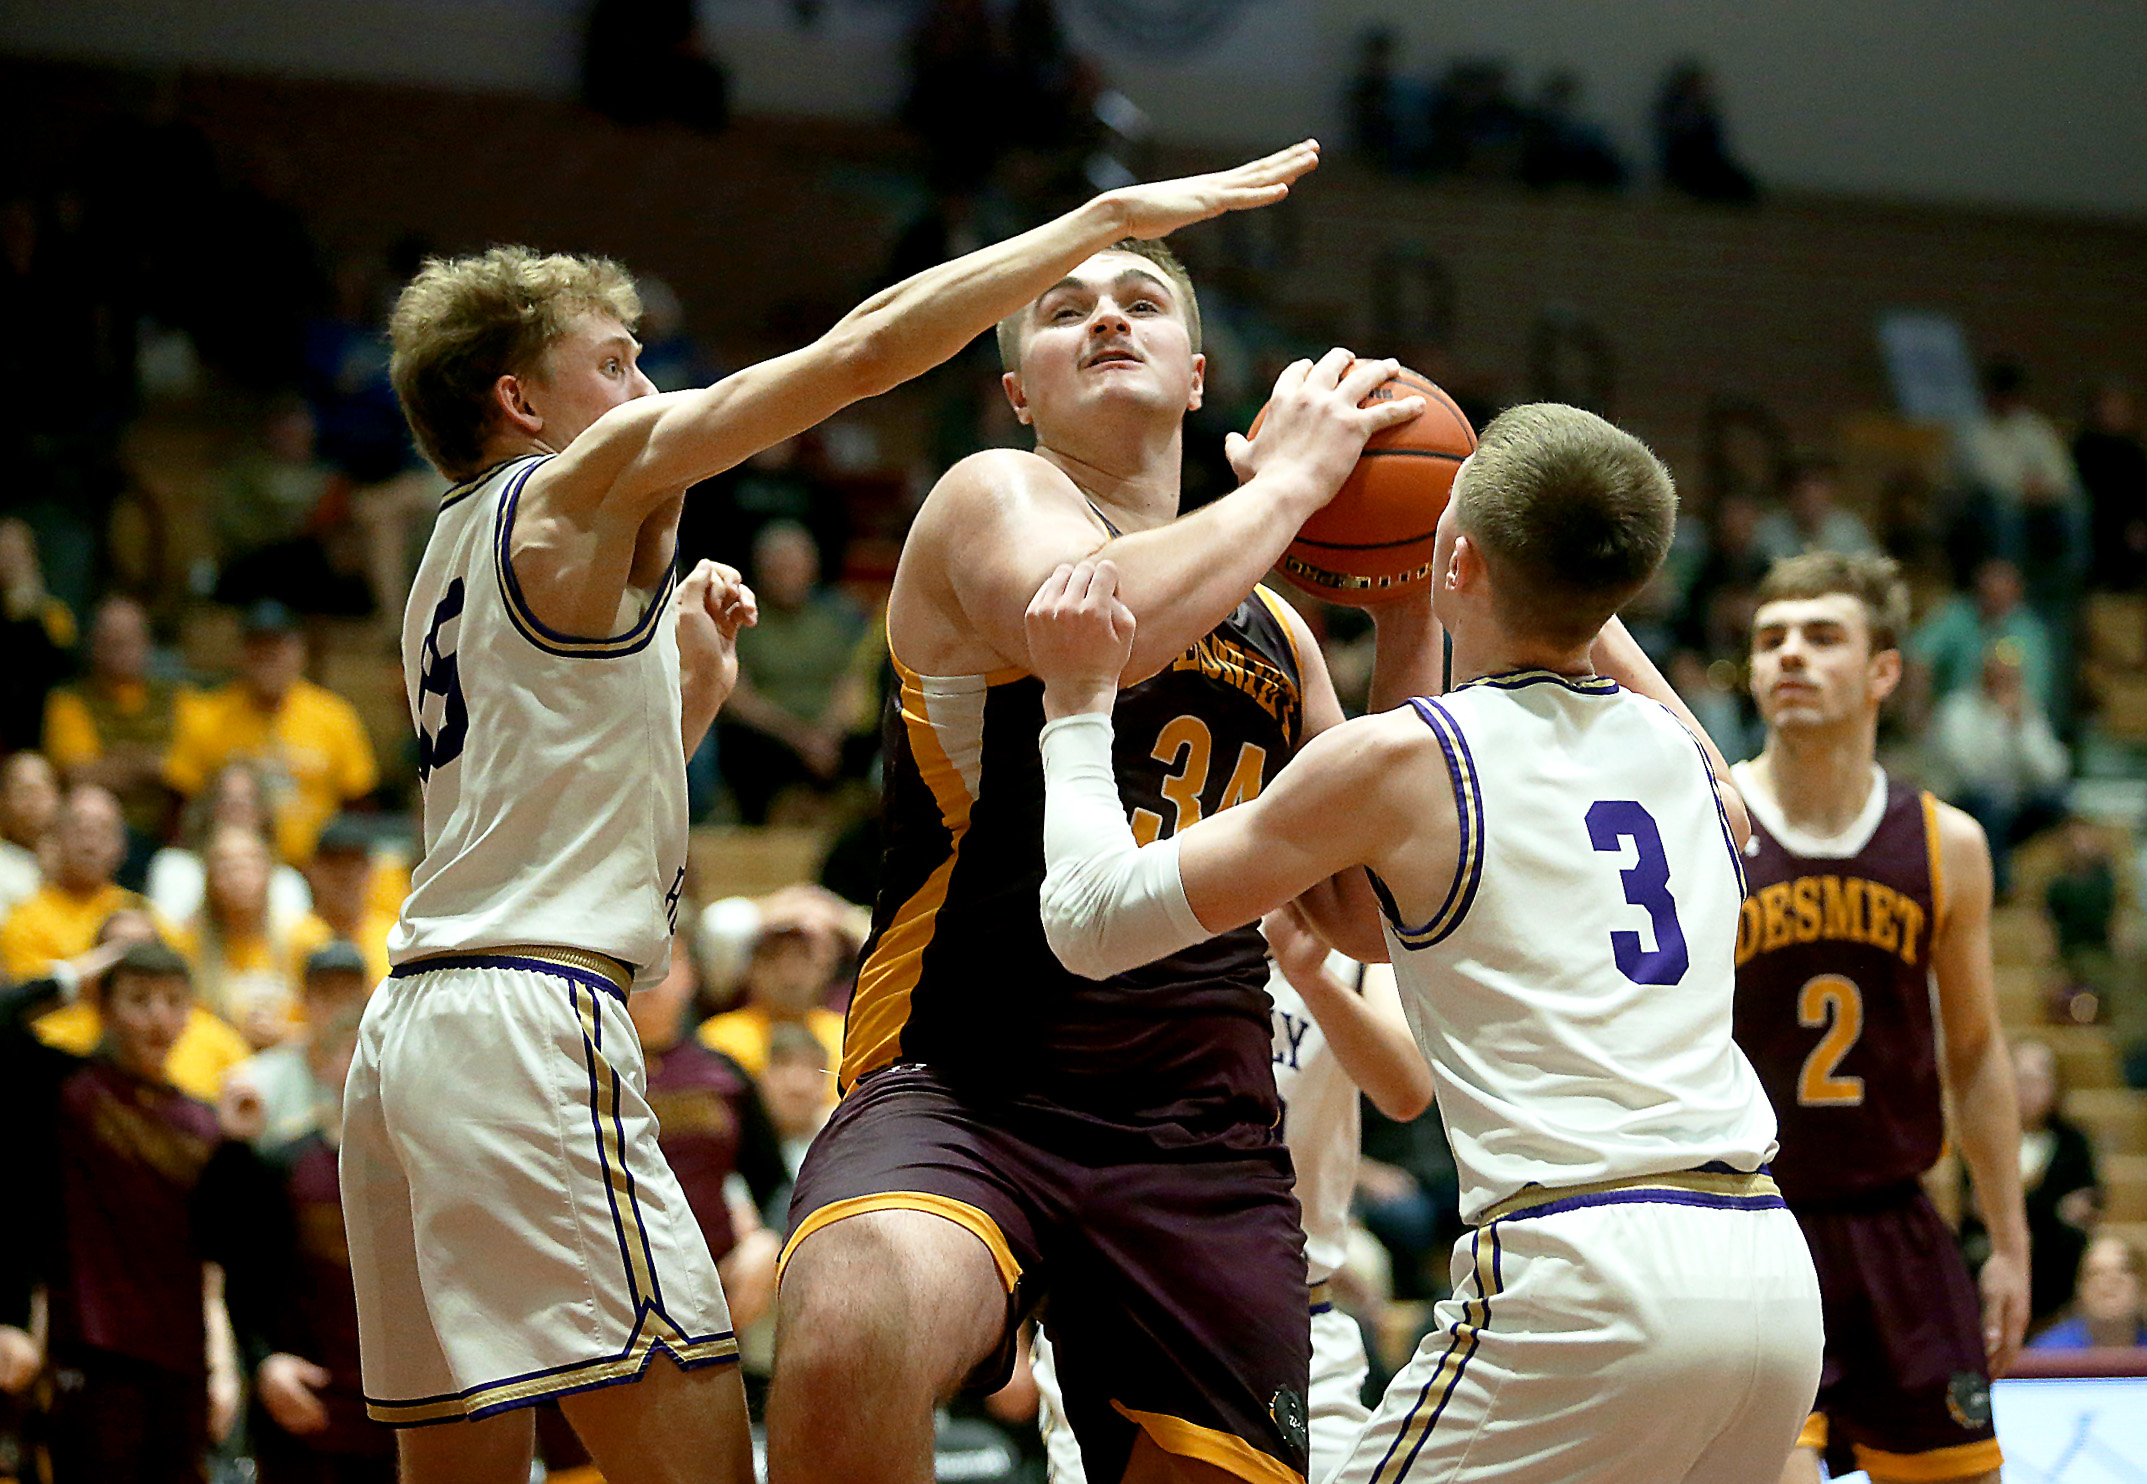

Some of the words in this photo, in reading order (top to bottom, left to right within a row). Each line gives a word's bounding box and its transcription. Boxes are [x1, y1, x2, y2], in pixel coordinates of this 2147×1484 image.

[1584, 801, 1689, 986] 3
[1735, 875, 1925, 966] DESMET
[1797, 973, 1865, 1107] 2
